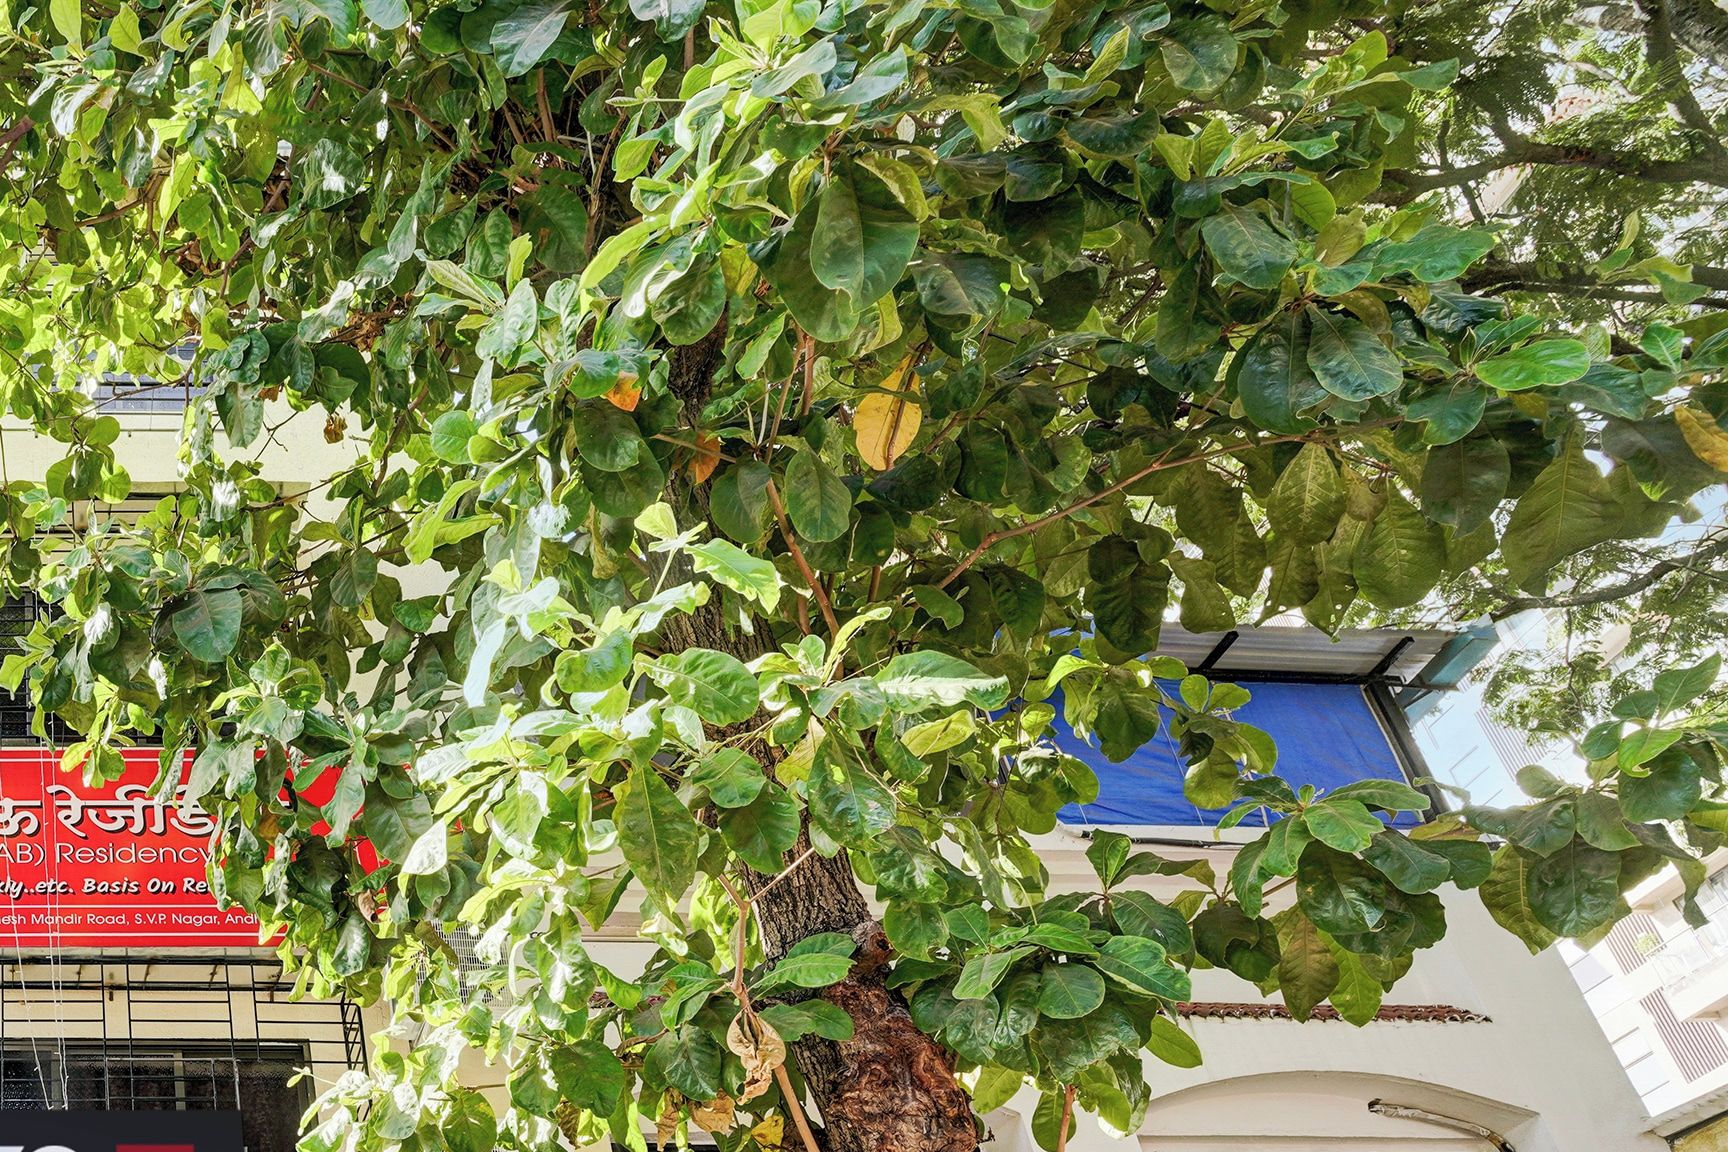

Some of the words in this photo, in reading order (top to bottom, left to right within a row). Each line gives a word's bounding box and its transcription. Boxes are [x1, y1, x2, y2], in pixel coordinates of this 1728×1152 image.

[56, 842, 211, 868] Residency
[82, 877, 140, 895] Basis
[147, 878, 176, 894] On
[183, 878, 211, 894] Re
[31, 913, 82, 926] Mandir
[87, 913, 130, 927] Road,
[172, 913, 220, 927] Nagar,
